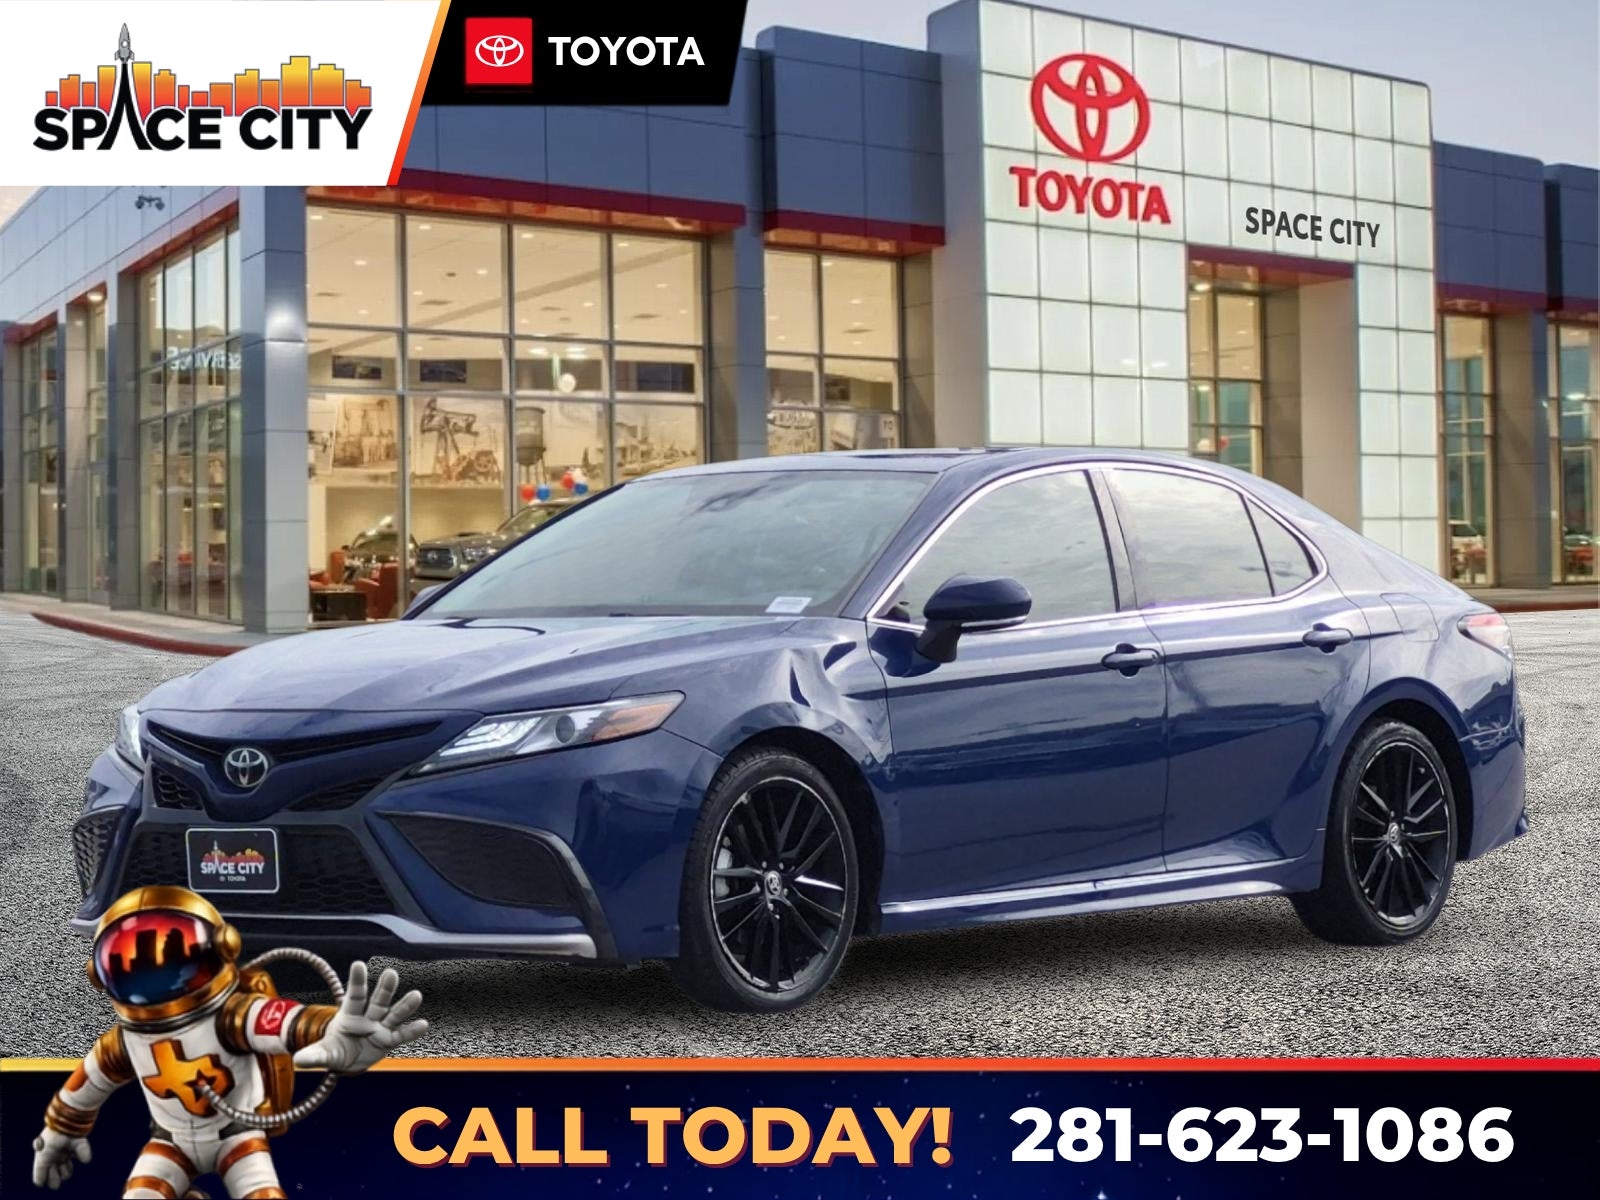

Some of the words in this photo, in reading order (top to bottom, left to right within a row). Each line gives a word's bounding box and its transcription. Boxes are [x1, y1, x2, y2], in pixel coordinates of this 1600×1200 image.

[1009, 166, 1172, 225] TOYOTA
[1245, 206, 1322, 242] SPACE
[1329, 217, 1381, 248] CITY
[201, 862, 235, 874] SPACE
[238, 862, 264, 874] CITY
